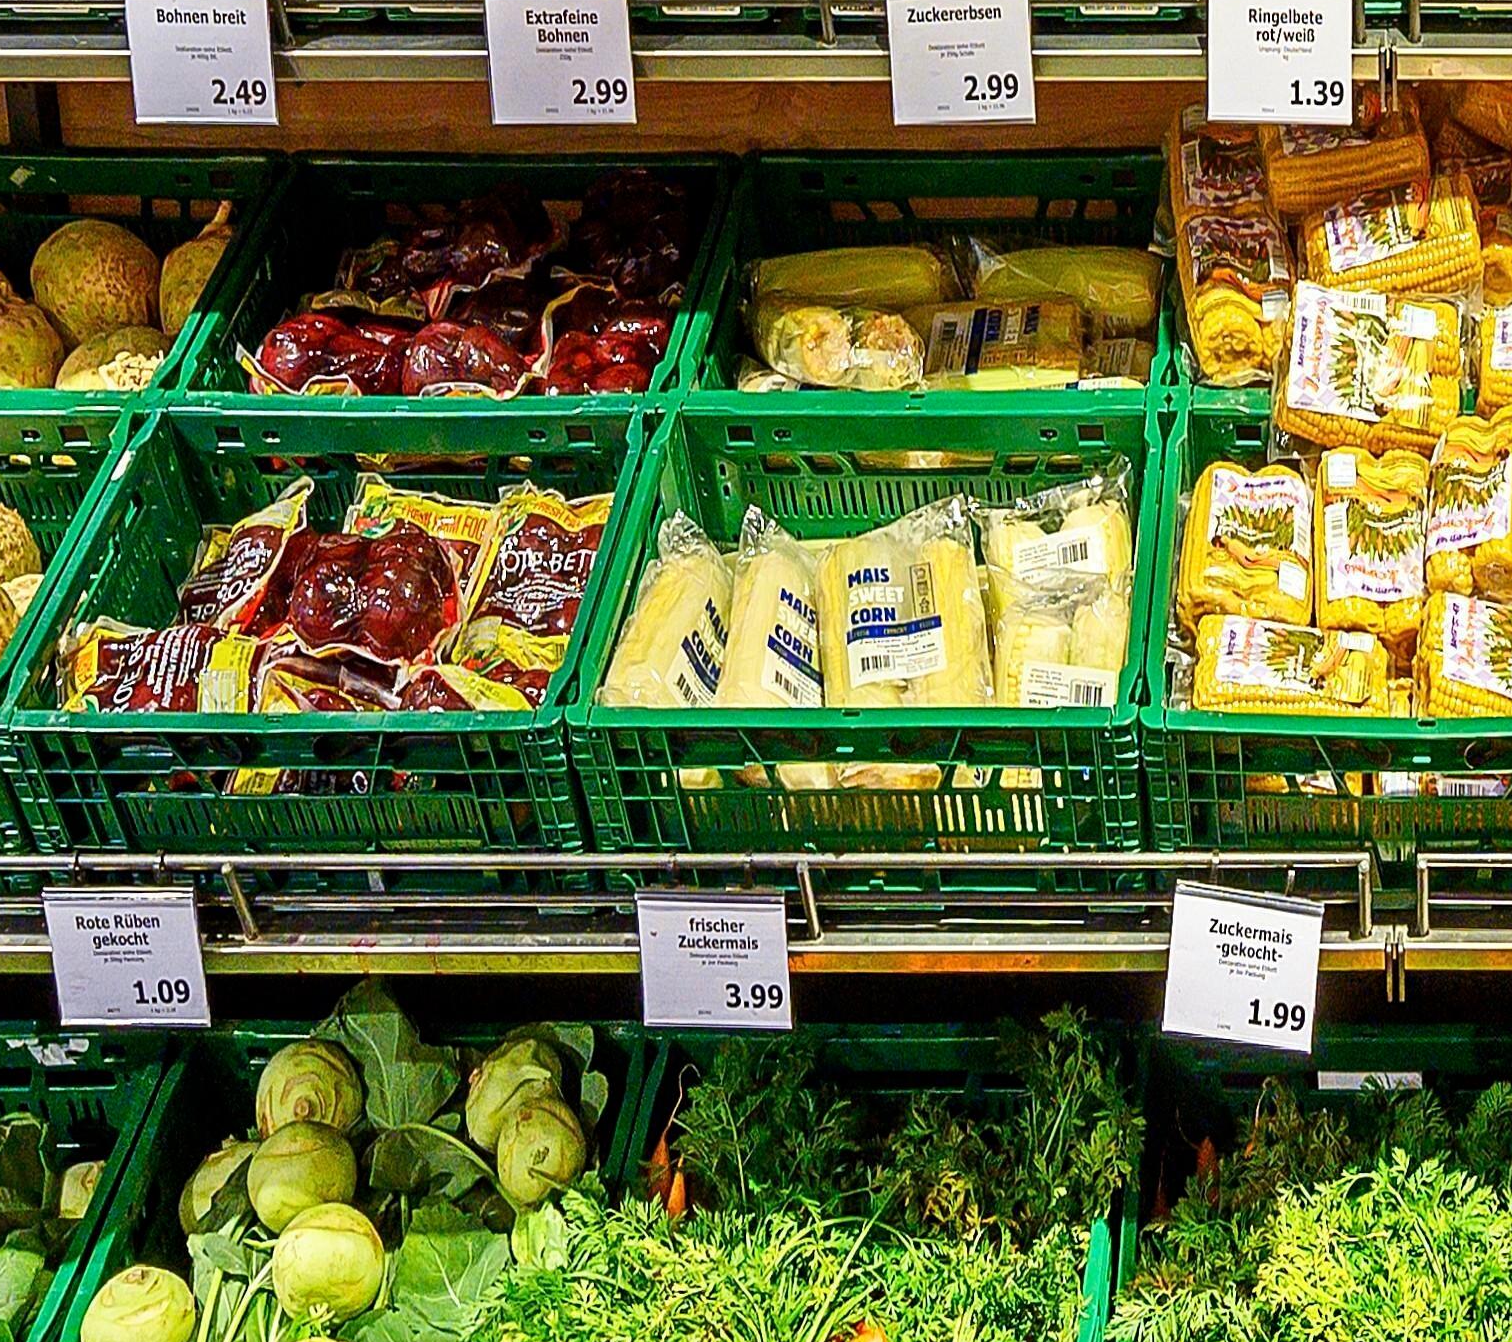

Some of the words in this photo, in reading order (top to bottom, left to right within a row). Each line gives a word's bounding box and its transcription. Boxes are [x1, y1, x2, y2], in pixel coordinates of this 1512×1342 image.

[156, 8, 209, 25] Bohnen
[212, 8, 247, 25] breit
[525, 8, 599, 25] Extrafeine
[907, 4, 1002, 23] Zuckererbsen
[1248, 7, 1323, 28] Ringelbete
[537, 27, 590, 43] Bohnen
[1256, 27, 1315, 45] rot/weiß
[211, 78, 267, 106] 2.49
[571, 78, 628, 105] 2.99
[963, 73, 1019, 102] 2.99
[1290, 79, 1345, 107] 1.39
[848, 568, 890, 588] MAIS
[780, 588, 817, 624] MAIS
[849, 586, 905, 605] SWEET
[851, 607, 897, 625] CORN
[775, 623, 813, 663] CORN
[691, 630, 721, 682] CORN
[75, 915, 111, 930] Rote
[113, 913, 161, 929] Rüben
[688, 917, 745, 934] frischer
[92, 931, 150, 950] gekocht
[677, 934, 759, 950] Zuckermais
[1209, 918, 1293, 949] Zuckermais
[1215, 941, 1283, 964] -gekocht-
[132, 978, 190, 1005] 1.09
[725, 983, 784, 1009] 3.99
[1248, 998, 1306, 1032] 1.99
